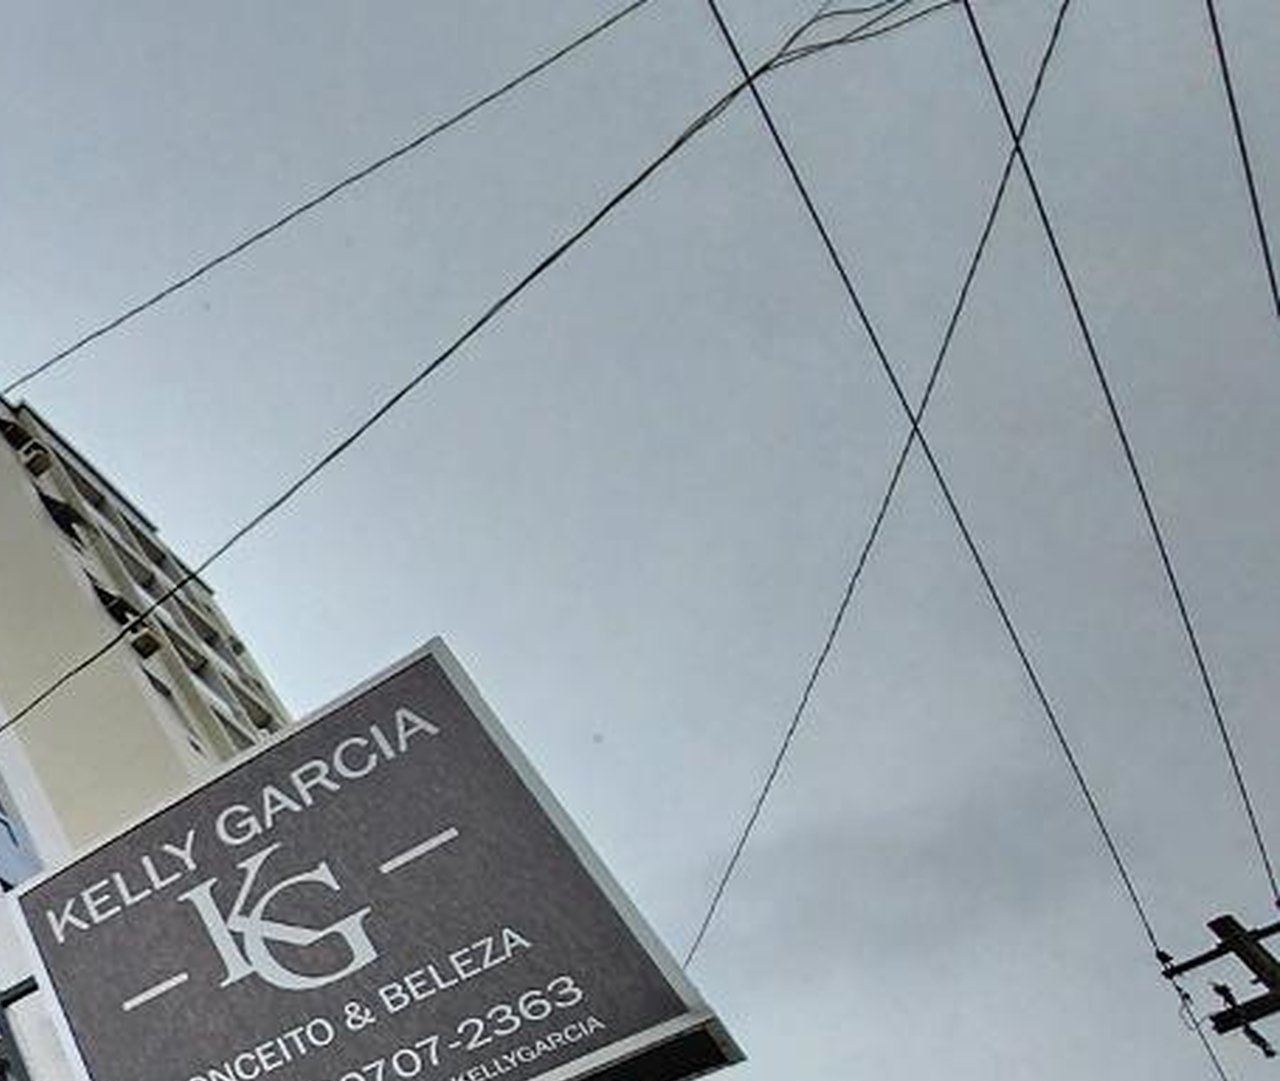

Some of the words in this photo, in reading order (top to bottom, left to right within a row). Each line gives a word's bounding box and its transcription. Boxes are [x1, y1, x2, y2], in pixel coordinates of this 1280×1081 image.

[46, 830, 197, 944] KELLY
[215, 706, 440, 846] GARCIA
[344, 1000, 377, 1032] &
[378, 926, 532, 1015] BELEZA
